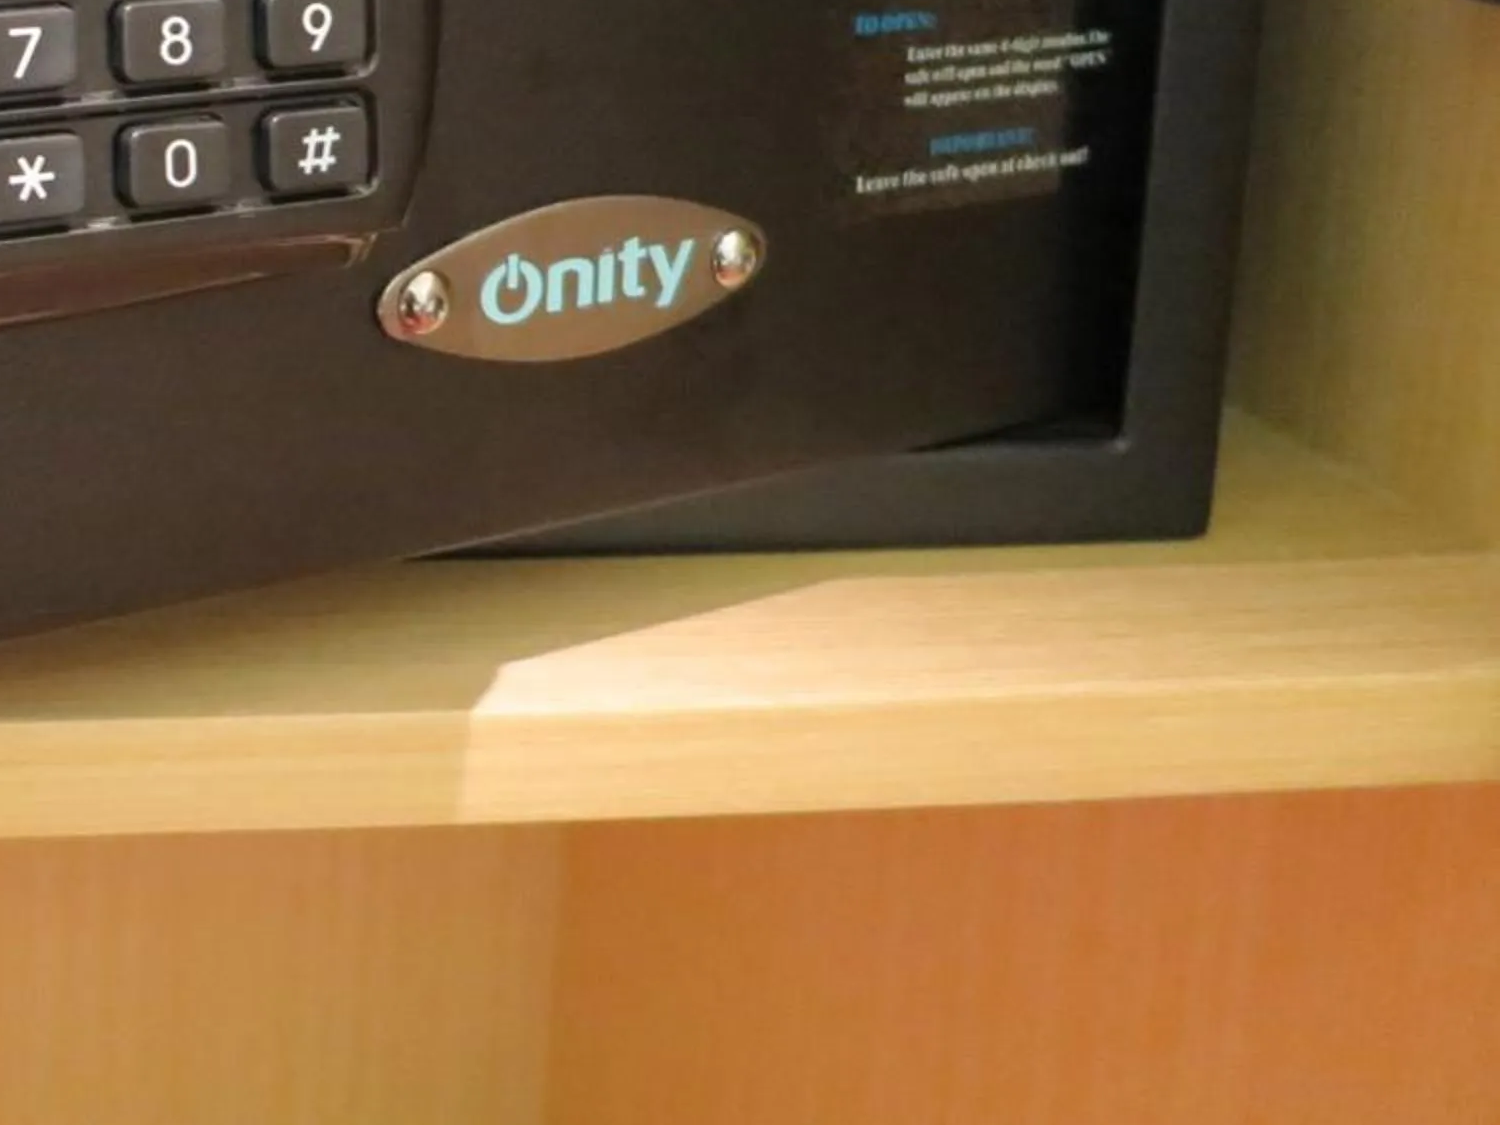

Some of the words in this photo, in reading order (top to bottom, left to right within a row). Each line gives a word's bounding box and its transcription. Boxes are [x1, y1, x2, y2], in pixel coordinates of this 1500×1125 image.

[7, 25, 44, 80] 7
[158, 15, 193, 66] 8
[301, 1, 334, 53] 9
[164, 138, 198, 189] 0
[479, 235, 695, 326] Onity
